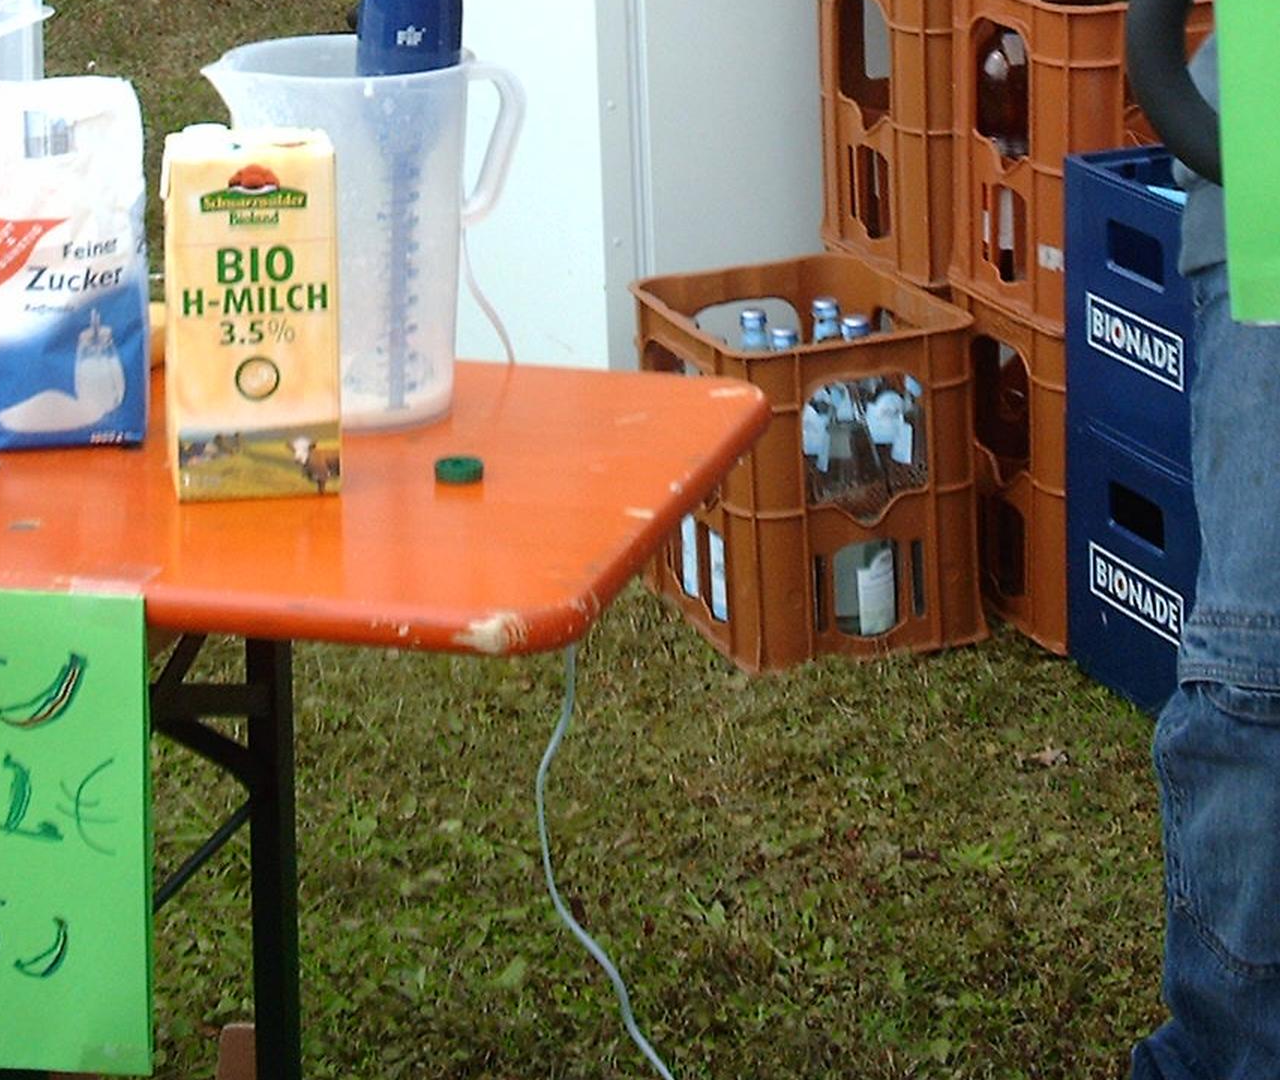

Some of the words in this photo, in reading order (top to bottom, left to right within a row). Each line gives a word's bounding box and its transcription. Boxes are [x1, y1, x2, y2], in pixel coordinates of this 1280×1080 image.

[25, 265, 123, 293] Zucker
[217, 245, 295, 284] BIO
[182, 283, 328, 316] H-MILCH
[1091, 306, 1179, 377] BIONADE
[1095, 555, 1179, 635] BIONADE
